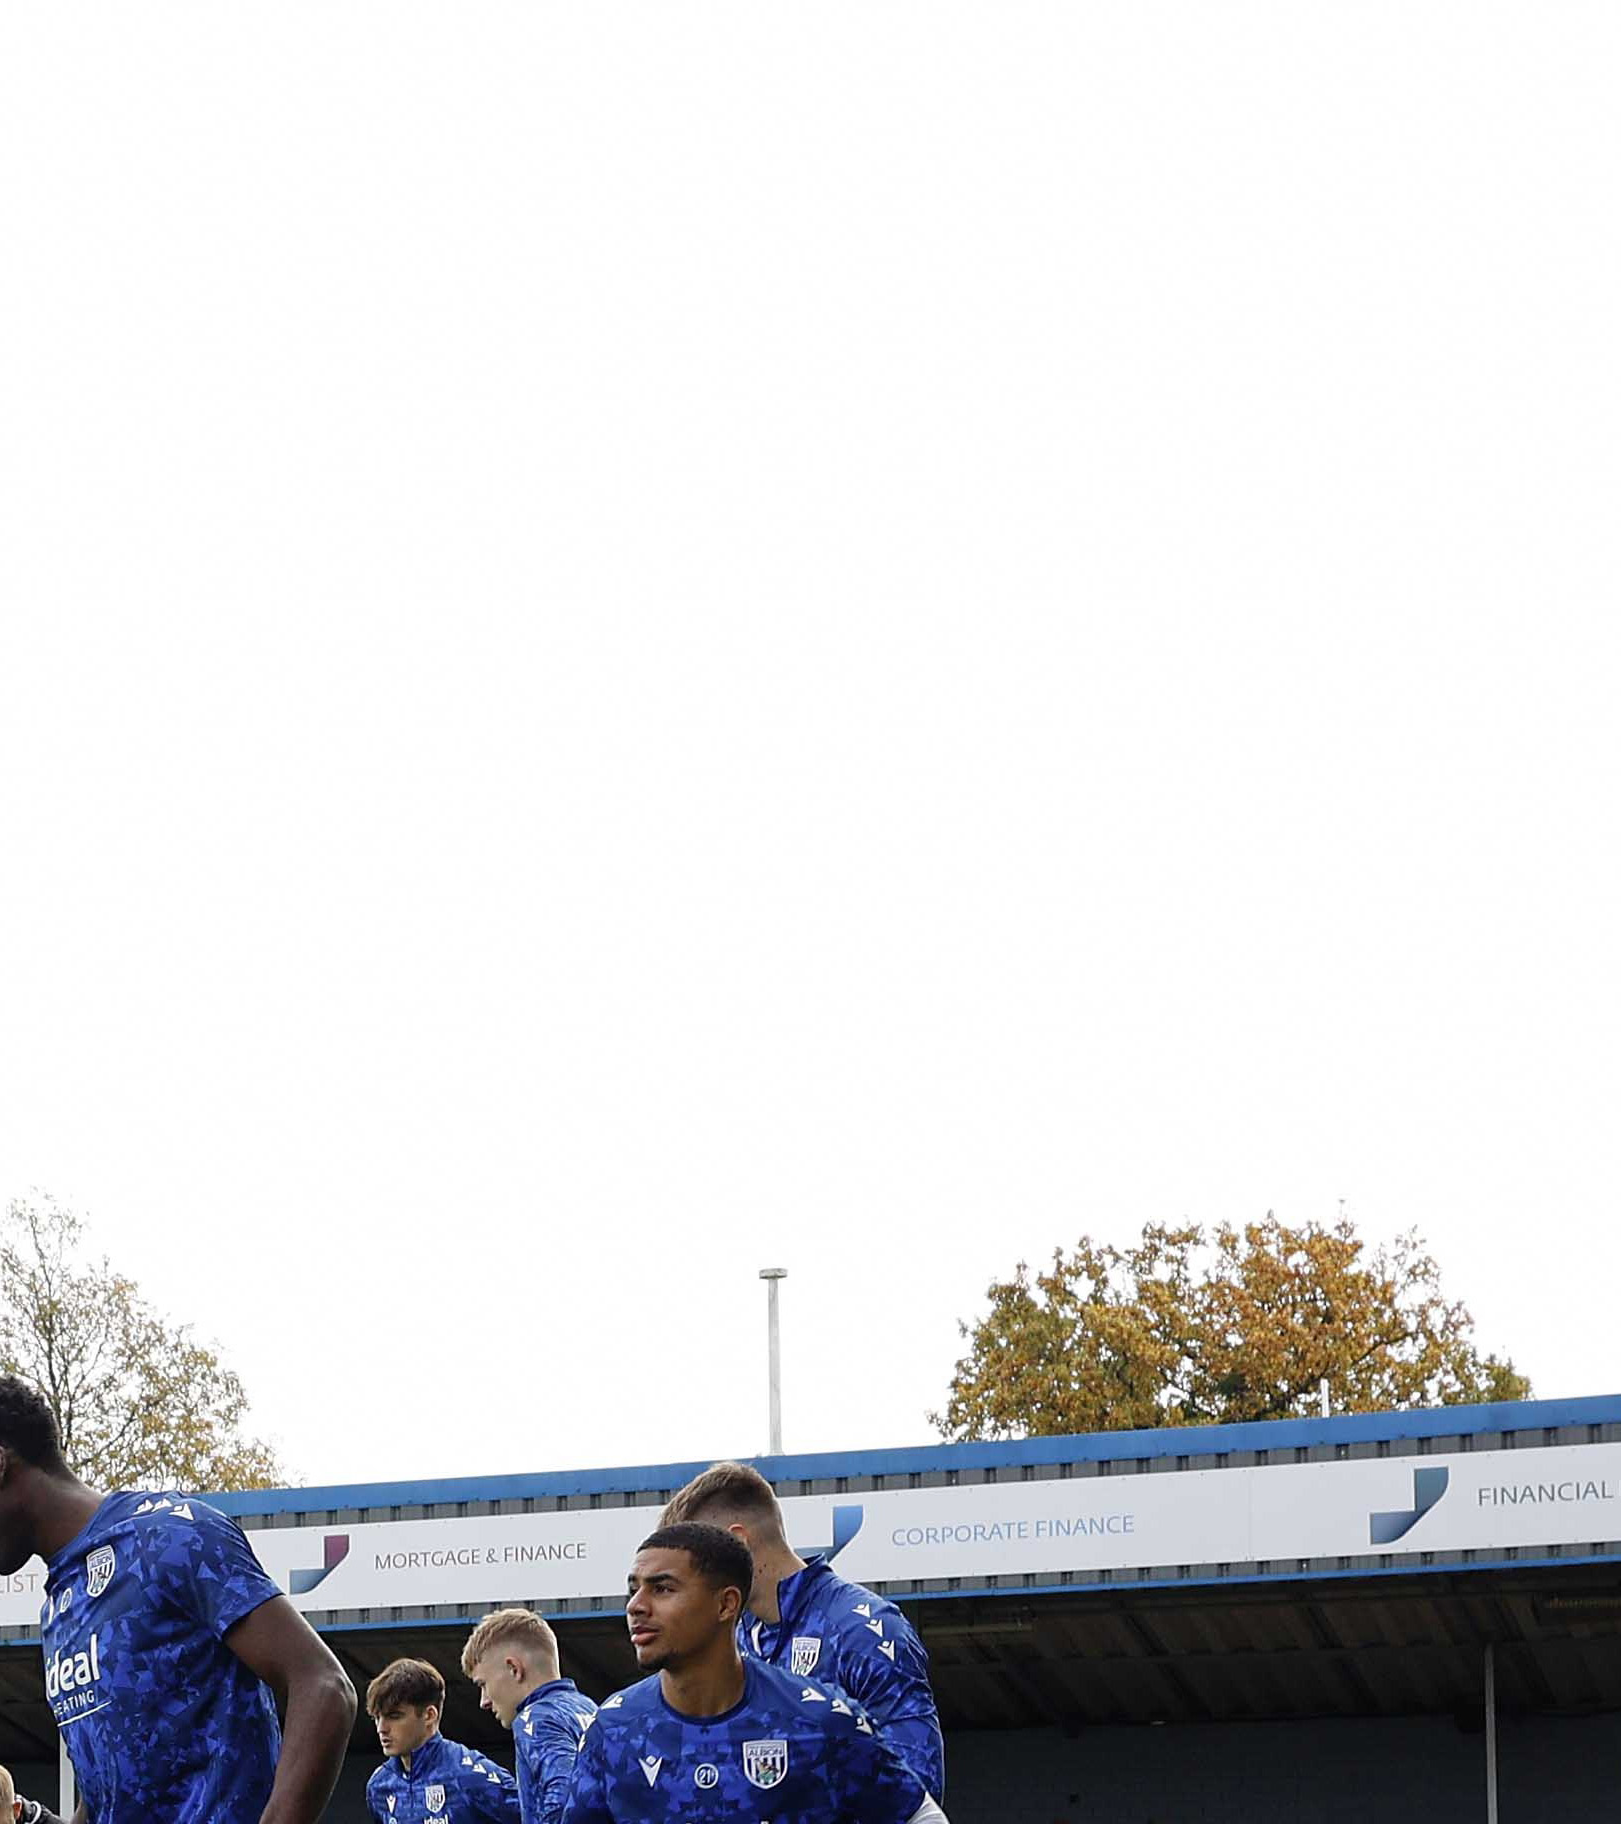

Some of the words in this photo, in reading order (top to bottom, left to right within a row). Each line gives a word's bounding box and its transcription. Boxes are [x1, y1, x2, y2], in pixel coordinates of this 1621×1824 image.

[1478, 1480, 1613, 1507] FINANCIAL
[891, 1521, 1028, 1546] CORPORATE
[1035, 1514, 1135, 1538] FINANCE
[374, 1549, 480, 1571] MORTGAGE
[485, 1548, 498, 1563] &
[504, 1543, 586, 1563] FINANCE
